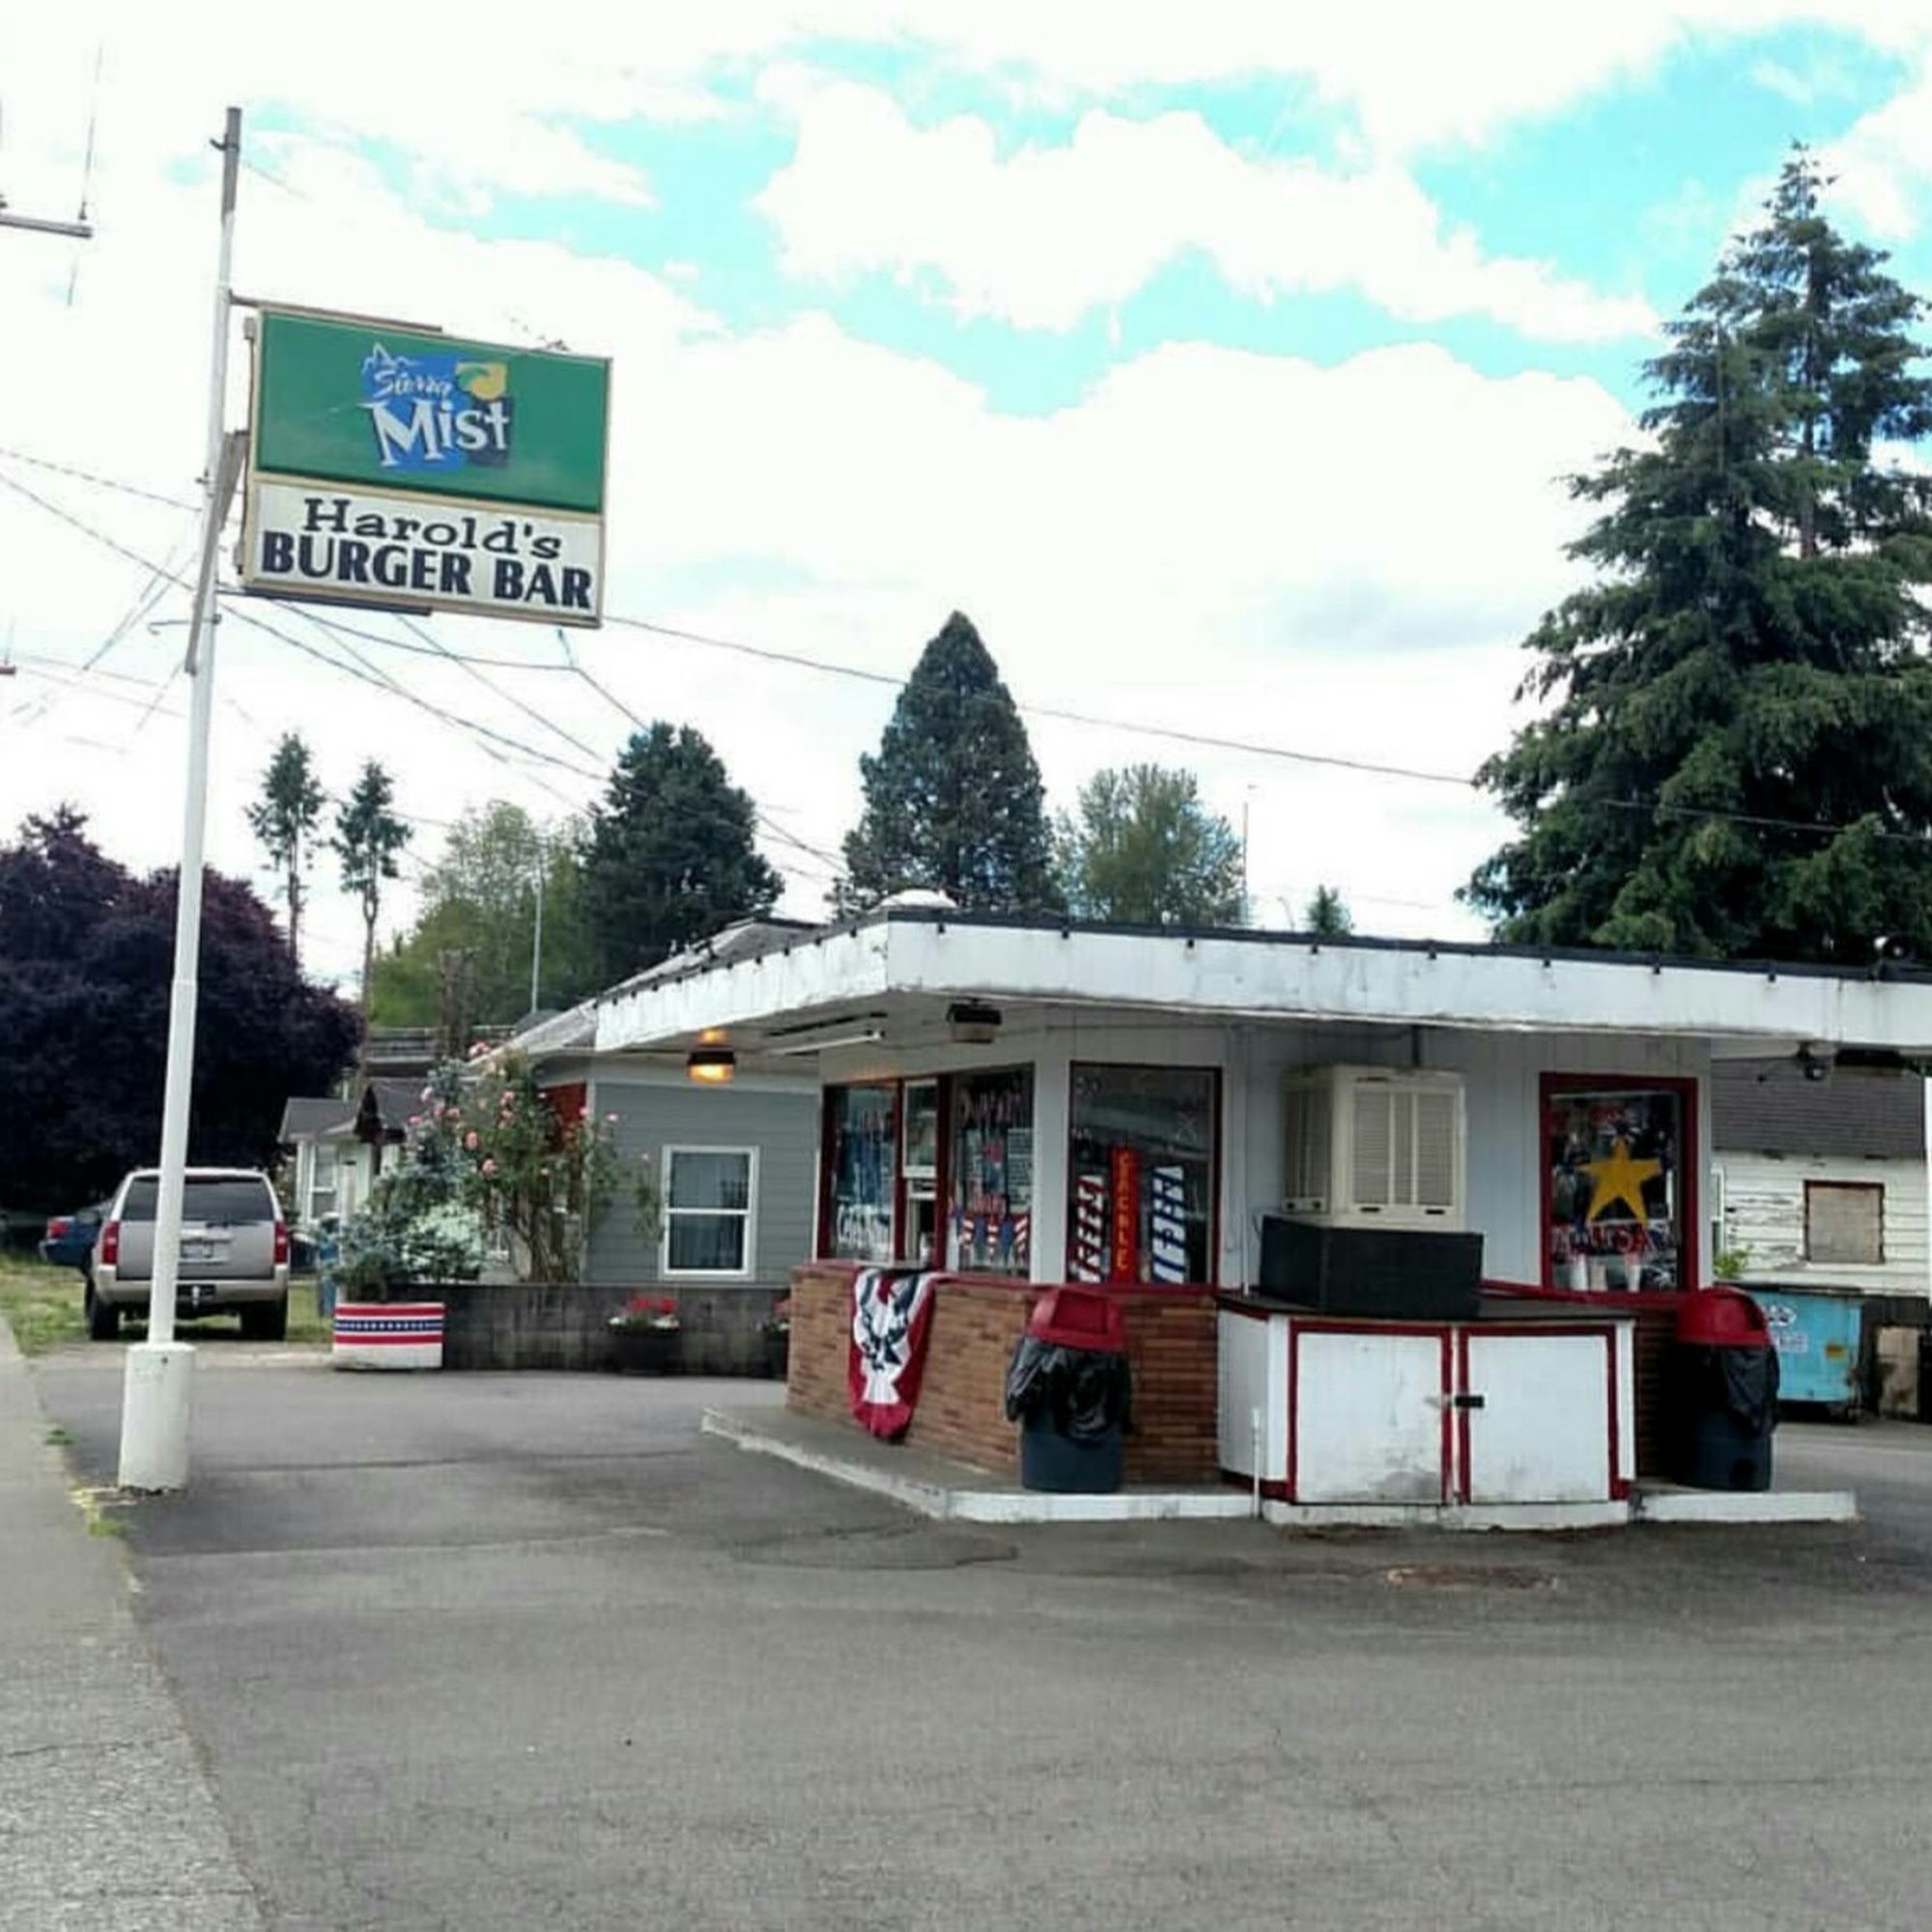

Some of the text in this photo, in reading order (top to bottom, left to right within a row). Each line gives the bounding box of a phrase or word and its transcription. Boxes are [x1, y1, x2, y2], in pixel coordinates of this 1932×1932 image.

[372, 369, 454, 399] Sierra
[356, 396, 510, 467] Mist
[303, 497, 562, 560] Harold's
[261, 529, 593, 611] BURGER BAR
